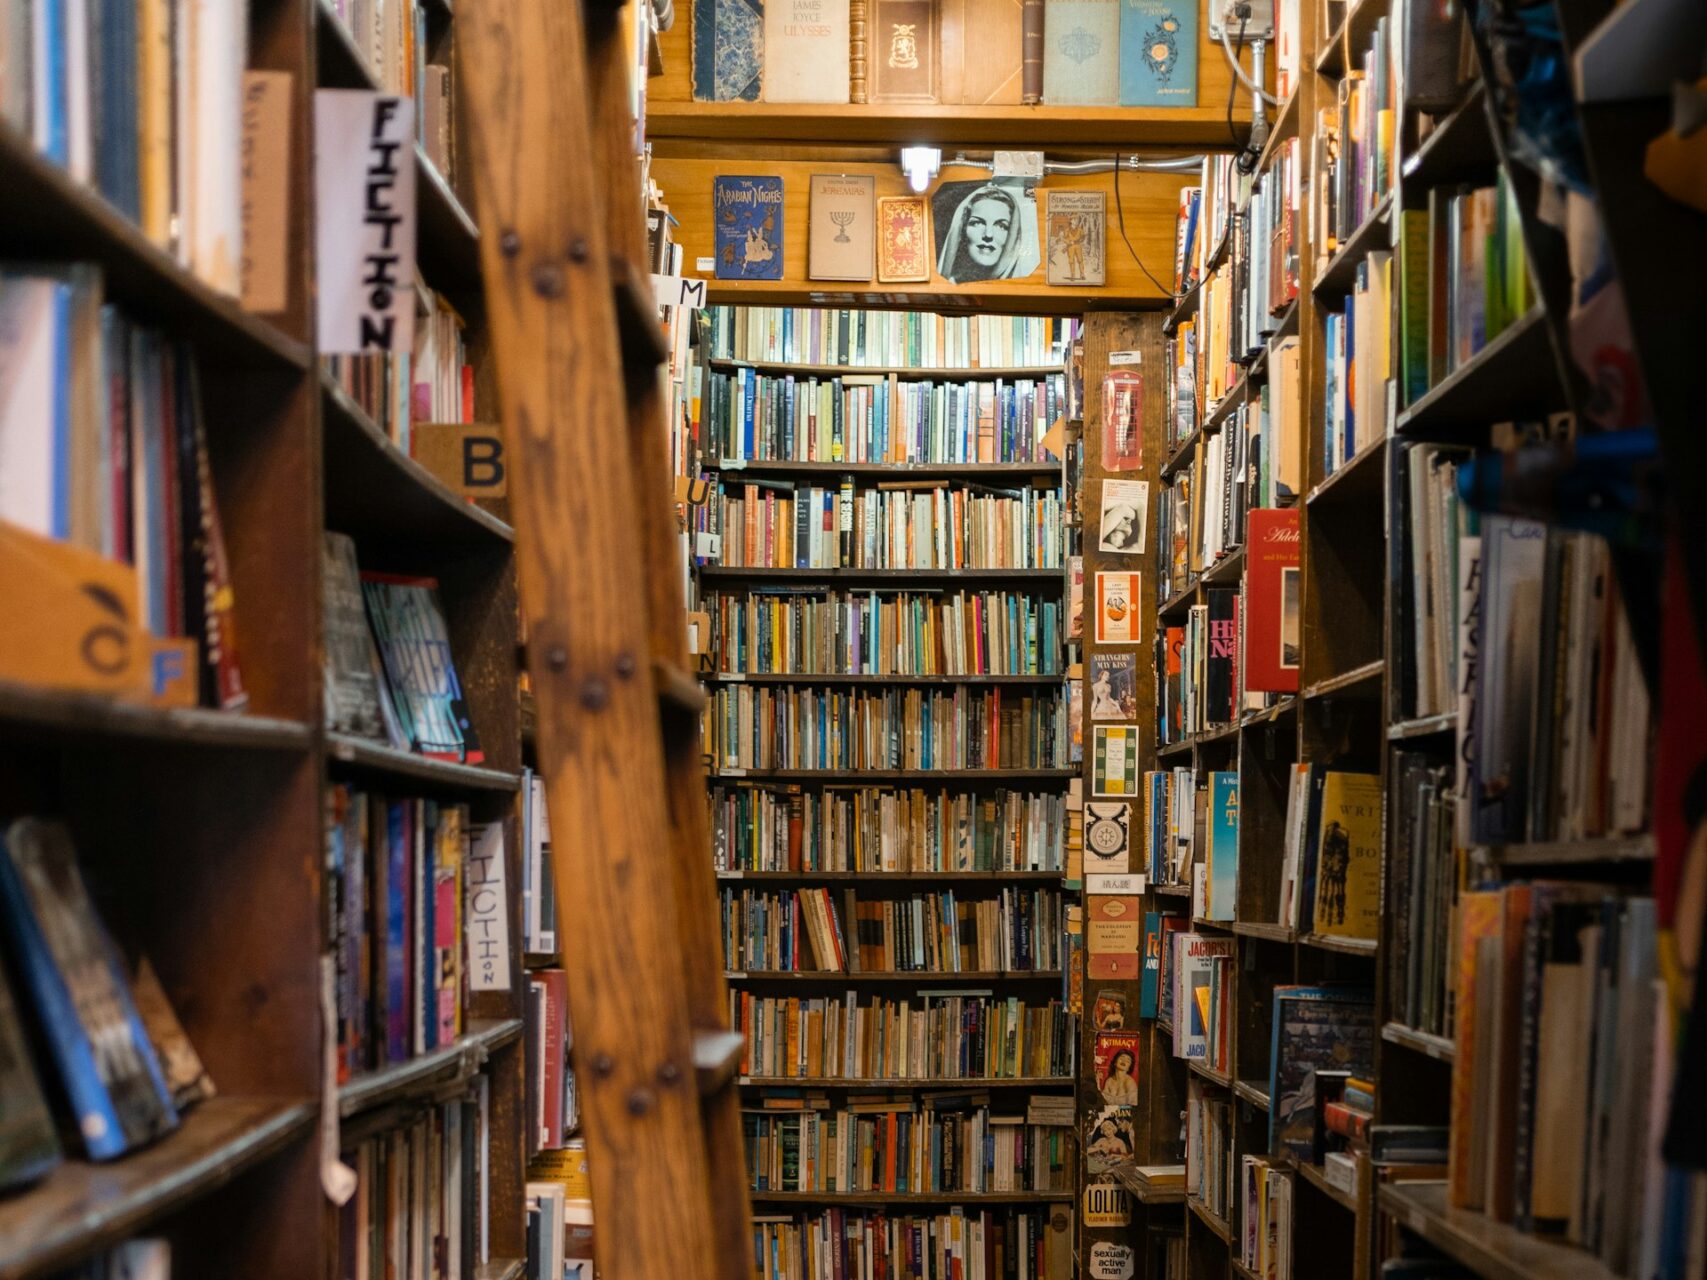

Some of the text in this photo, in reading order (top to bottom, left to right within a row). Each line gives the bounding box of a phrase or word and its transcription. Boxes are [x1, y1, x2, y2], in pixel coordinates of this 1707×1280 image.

[793, 13, 820, 22] JOYCE
[784, 25, 831, 36] ULYSSES
[718, 184, 782, 208] ARABIAN NIGHTS
[821, 187, 865, 196] JEREMIAS
[1051, 196, 1072, 205] STRONG
[1078, 196, 1101, 205] STEADY
[360, 98, 402, 349] FICTION
[680, 280, 703, 307] M
[463, 437, 504, 487] B
[687, 478, 709, 506] U
[709, 539, 716, 554] L
[701, 650, 718, 671] N
[1094, 653, 1130, 661] STRANGERS
[151, 652, 185, 697] F
[463, 827, 500, 984] FICTION
[1188, 942, 1225, 957] JACOB'S
[1101, 1039, 1136, 1047] INTIMACY
[1088, 1189, 1128, 1213] LOLITA
[1094, 1249, 1131, 1259] sexually
[1098, 1259, 1125, 1267] active
[1102, 1267, 1121, 1275] man
